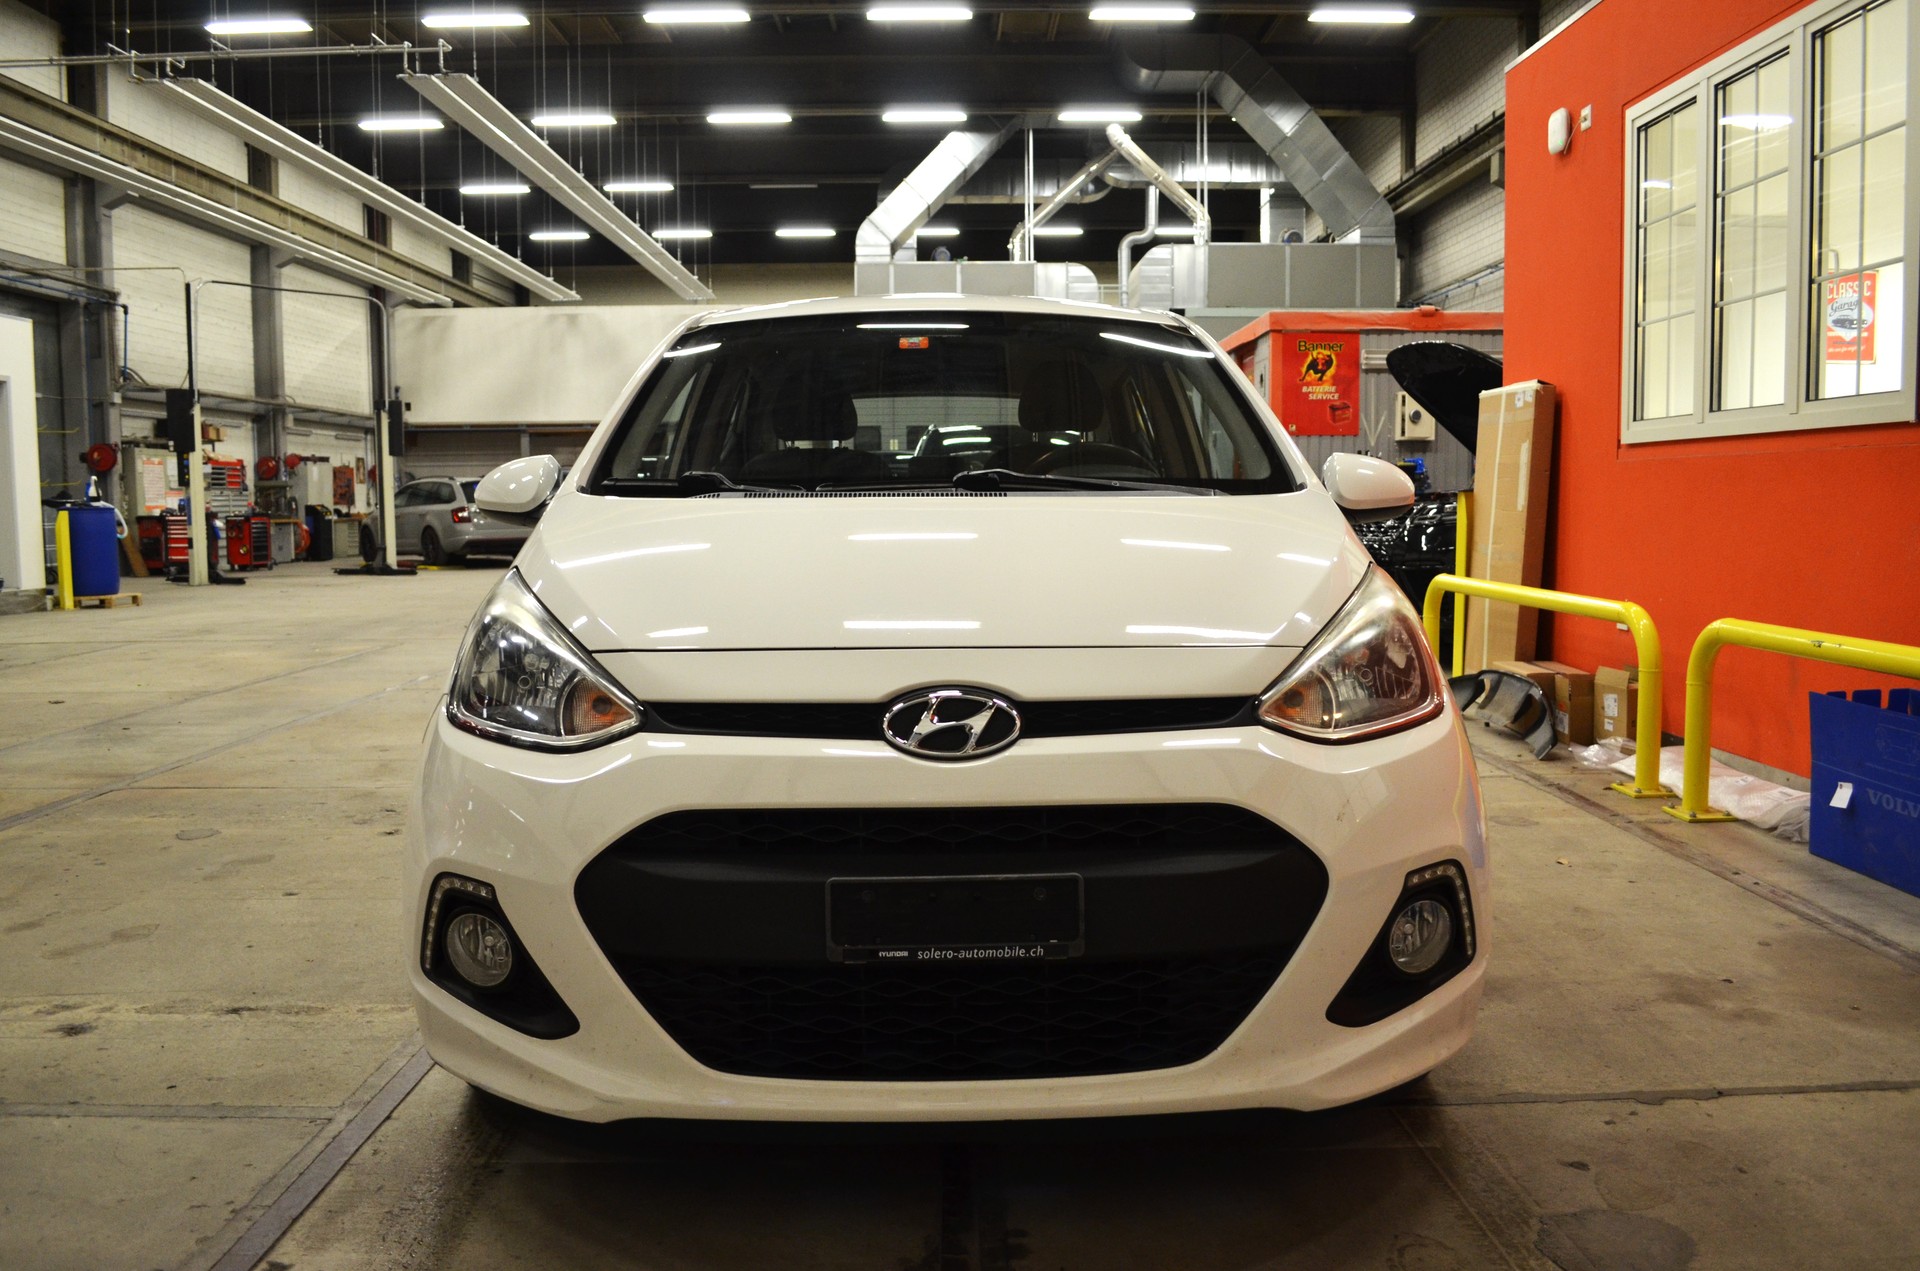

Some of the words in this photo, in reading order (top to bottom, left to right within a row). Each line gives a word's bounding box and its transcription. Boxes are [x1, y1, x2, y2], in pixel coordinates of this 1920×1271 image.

[1827, 281, 1871, 299] CLASSC
[1829, 300, 1861, 317] Garag
[1298, 340, 1344, 352] Banner
[917, 946, 1044, 959] solero-automobile.ch
